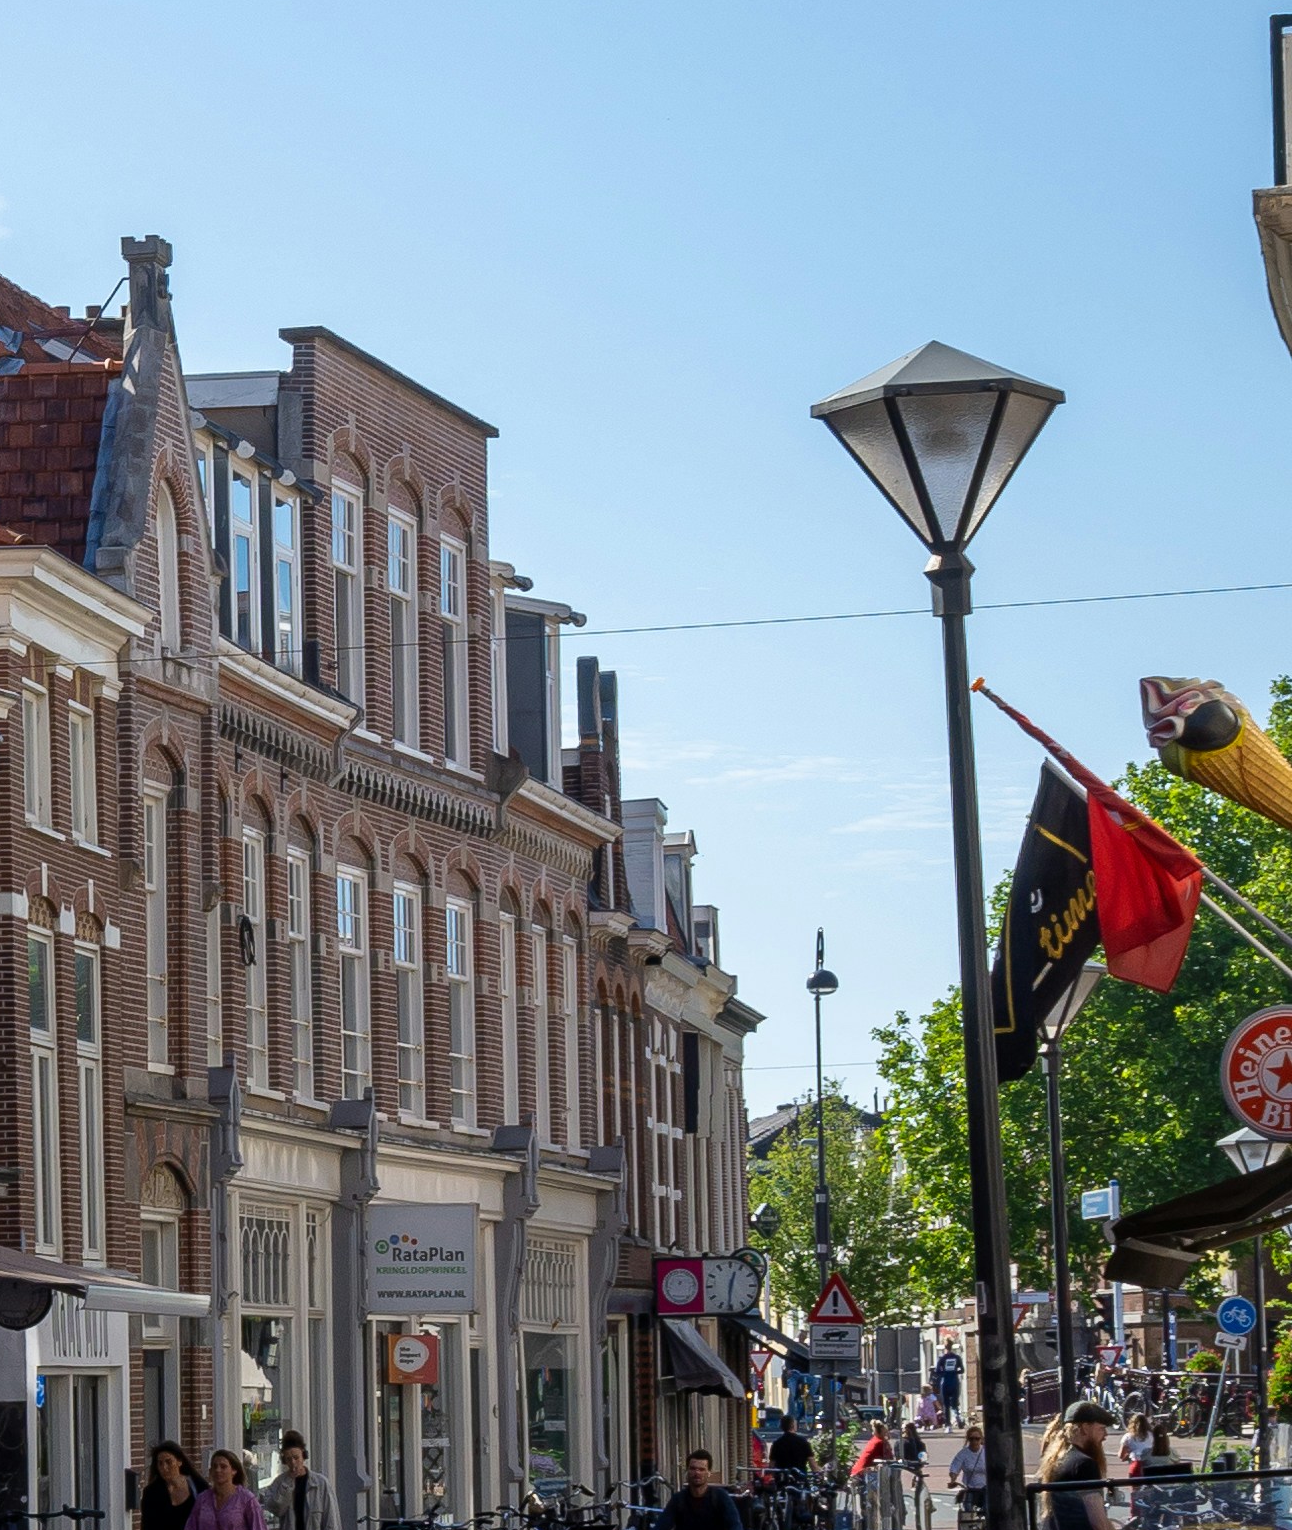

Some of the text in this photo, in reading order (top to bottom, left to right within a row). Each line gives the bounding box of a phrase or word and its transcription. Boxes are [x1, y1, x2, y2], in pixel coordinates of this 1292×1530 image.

[1233, 1026, 1292, 1103] Heine
[1260, 1100, 1292, 1130] Bi
[392, 1247, 465, 1262] RataPlan
[376, 1266, 467, 1275] KRINGLOOPWINKEL
[377, 1289, 467, 1299] WWW.RATAPLAN.NL
